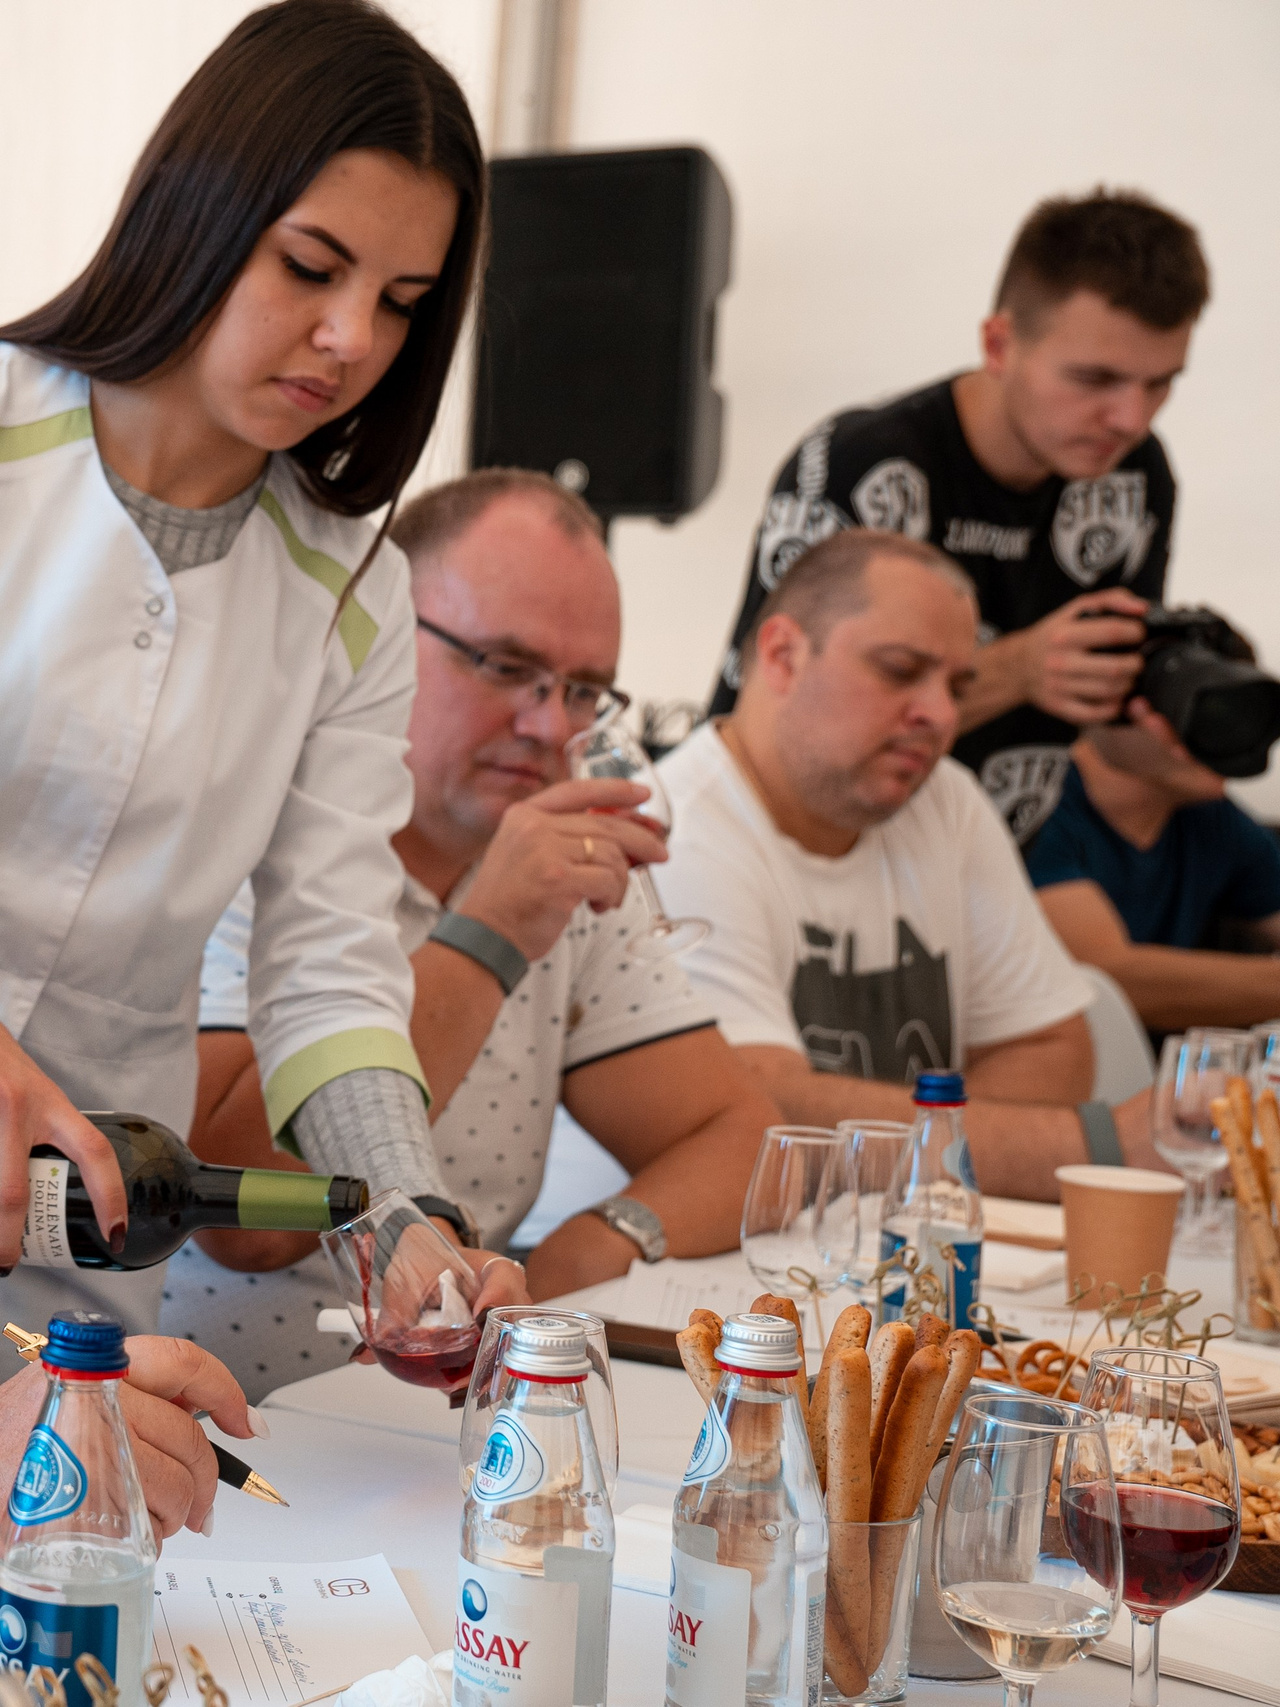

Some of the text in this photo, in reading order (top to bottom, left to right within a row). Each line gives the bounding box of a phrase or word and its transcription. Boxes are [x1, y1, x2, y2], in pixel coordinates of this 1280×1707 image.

[35, 1179, 45, 1232] DOLINA
[455, 1612, 531, 1669] ASSAY
[494, 1669, 522, 1681] WATER
